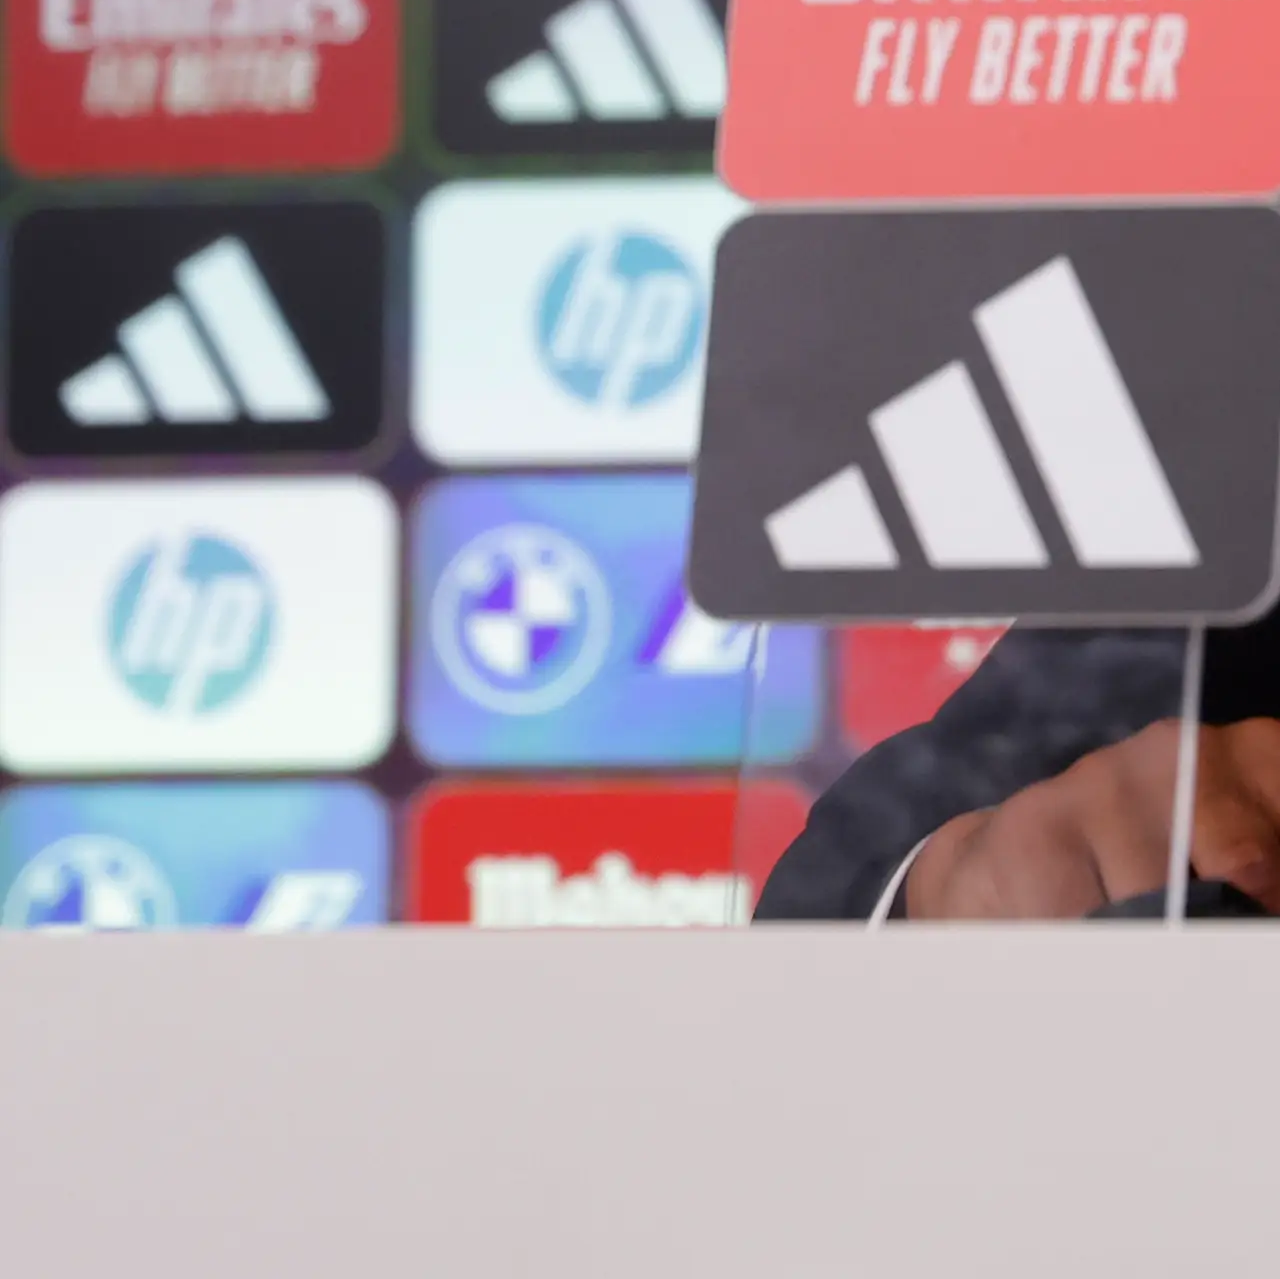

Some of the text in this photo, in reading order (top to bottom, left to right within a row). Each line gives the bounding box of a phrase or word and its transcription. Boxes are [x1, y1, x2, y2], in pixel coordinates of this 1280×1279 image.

[854, 14, 1188, 107] FLY BETTER
[547, 228, 698, 410] hp
[124, 531, 267, 716] hp
